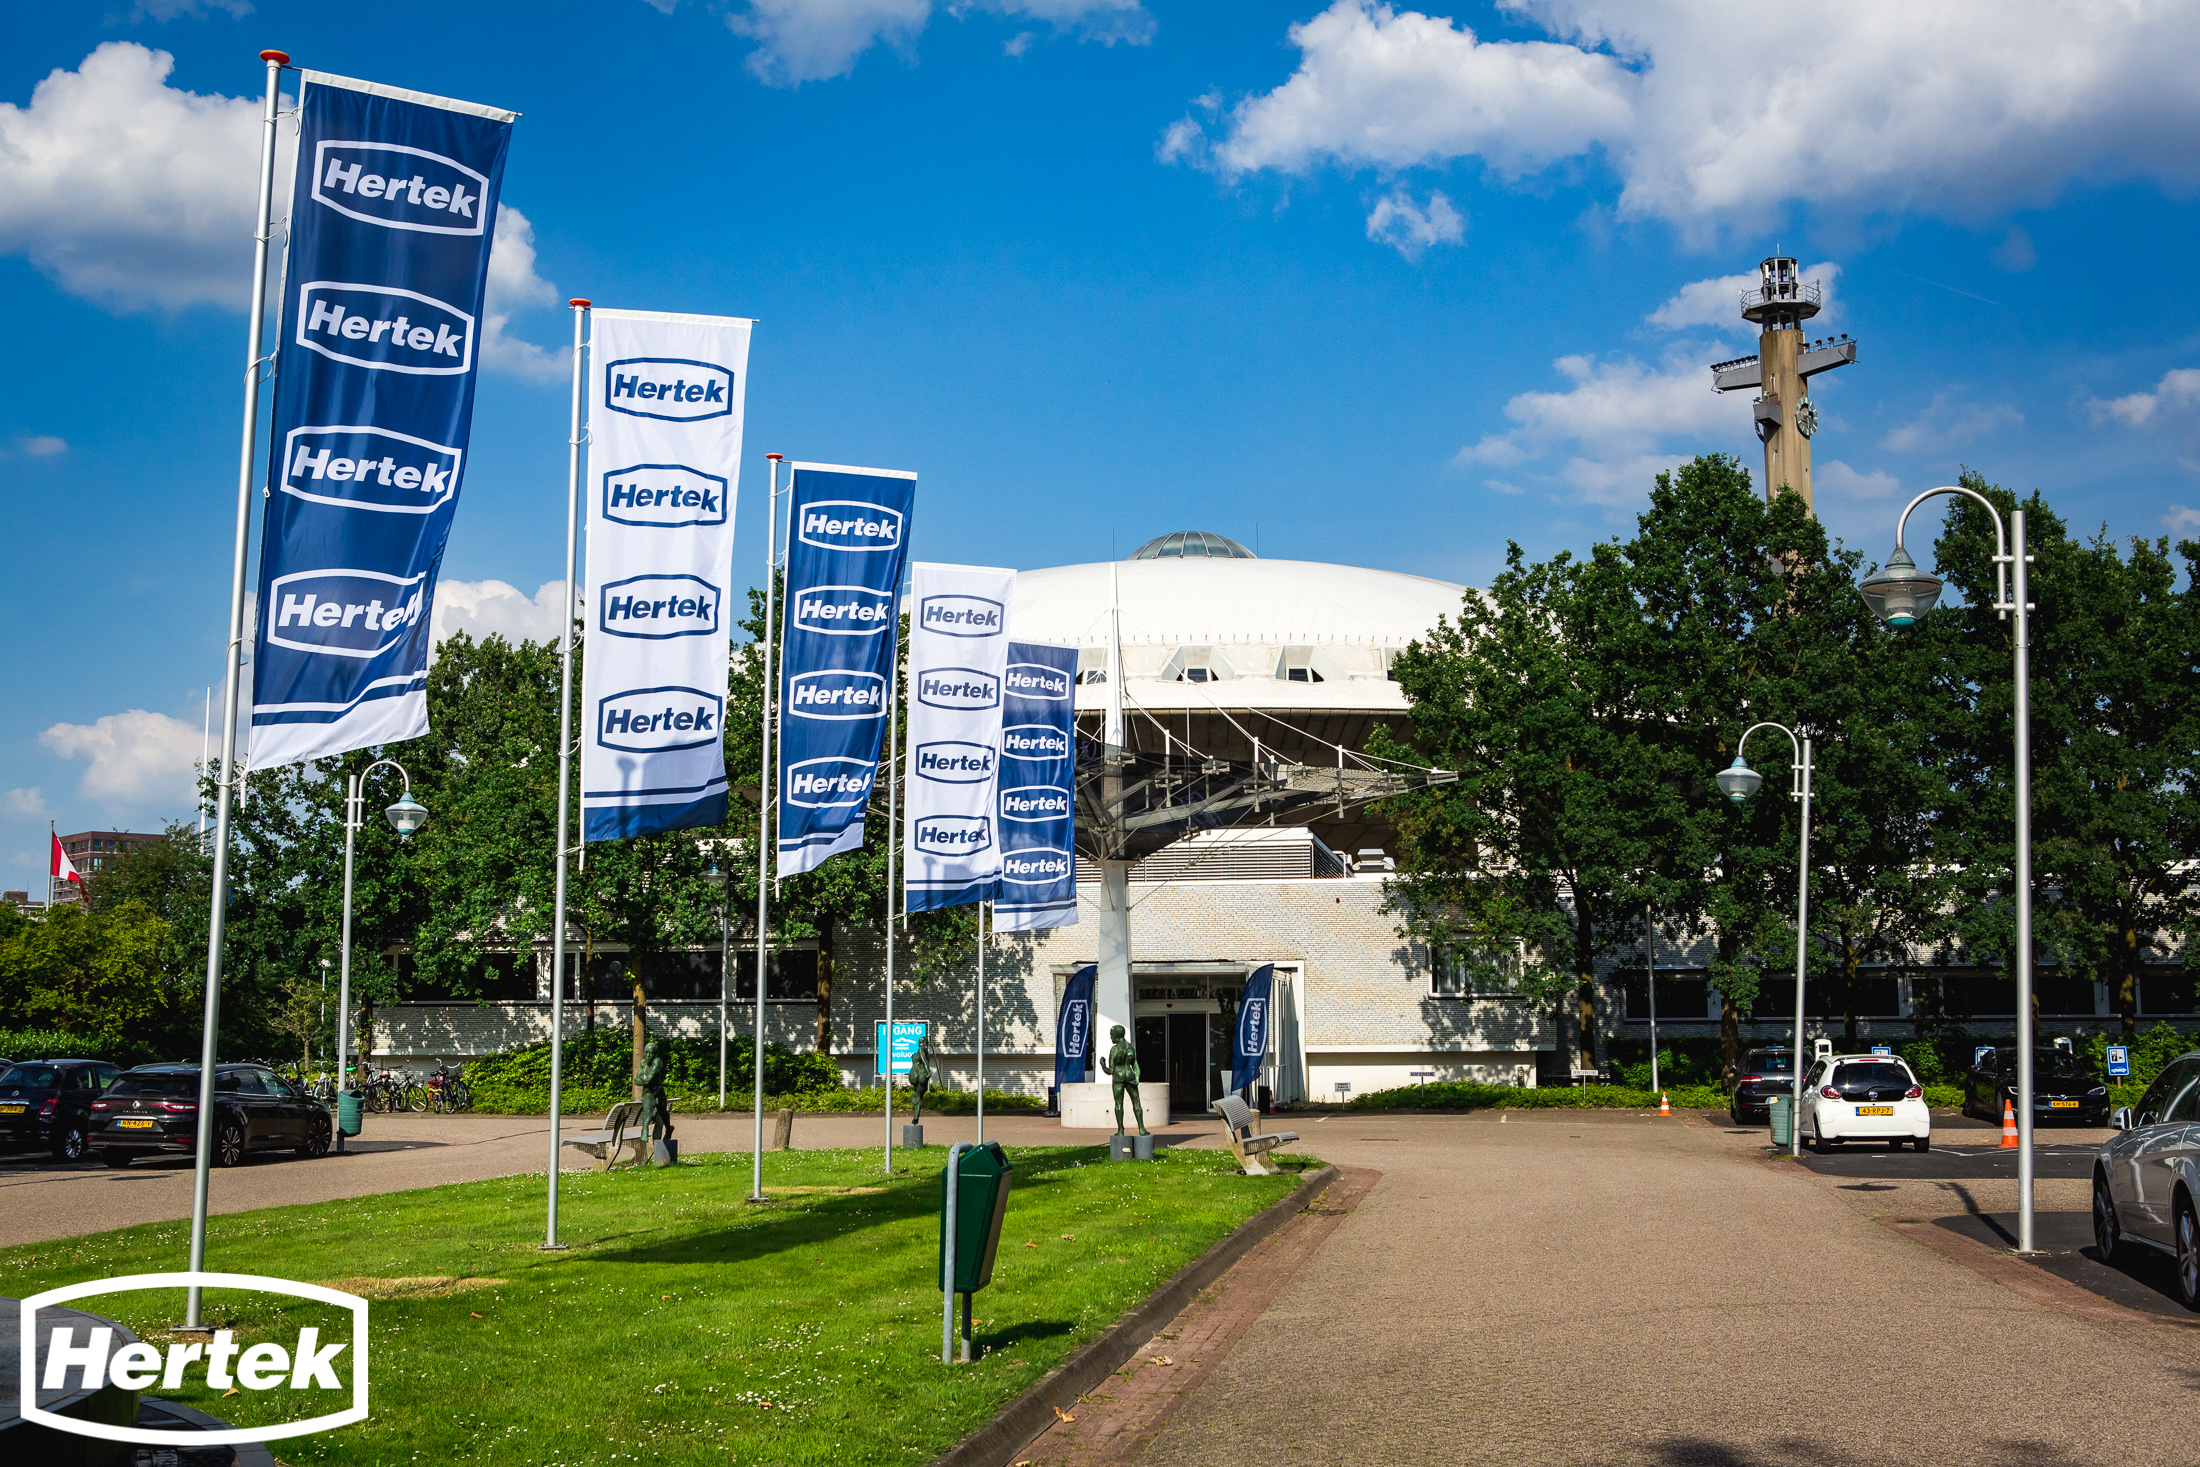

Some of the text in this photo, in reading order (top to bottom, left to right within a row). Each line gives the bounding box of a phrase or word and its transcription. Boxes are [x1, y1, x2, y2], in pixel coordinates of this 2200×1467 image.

[324, 158, 476, 218] Hertek
[308, 300, 462, 357] Hertek
[614, 374, 725, 402] Hertek
[291, 445, 451, 492] Hertek
[611, 484, 719, 512] Hertek
[806, 514, 896, 539] Hertek
[278, 581, 423, 631] Hertek
[608, 595, 712, 620] Hertek
[800, 600, 888, 621] Hertek
[926, 606, 998, 626] Hertek
[923, 680, 994, 698] Hertek
[1007, 673, 1064, 692] Hertek
[795, 685, 880, 706] Hertek
[605, 707, 714, 733] Hertek
[1006, 735, 1065, 751] Hertek
[921, 753, 991, 771] Hertek
[1005, 796, 1066, 811] Hertek
[920, 827, 986, 843] Hertek
[1005, 859, 1066, 873] Hertek
[883, 1026, 922, 1036] IGANG
[1069, 1003, 1084, 1054] Hertek
[1248, 1001, 1262, 1053] Hertek
